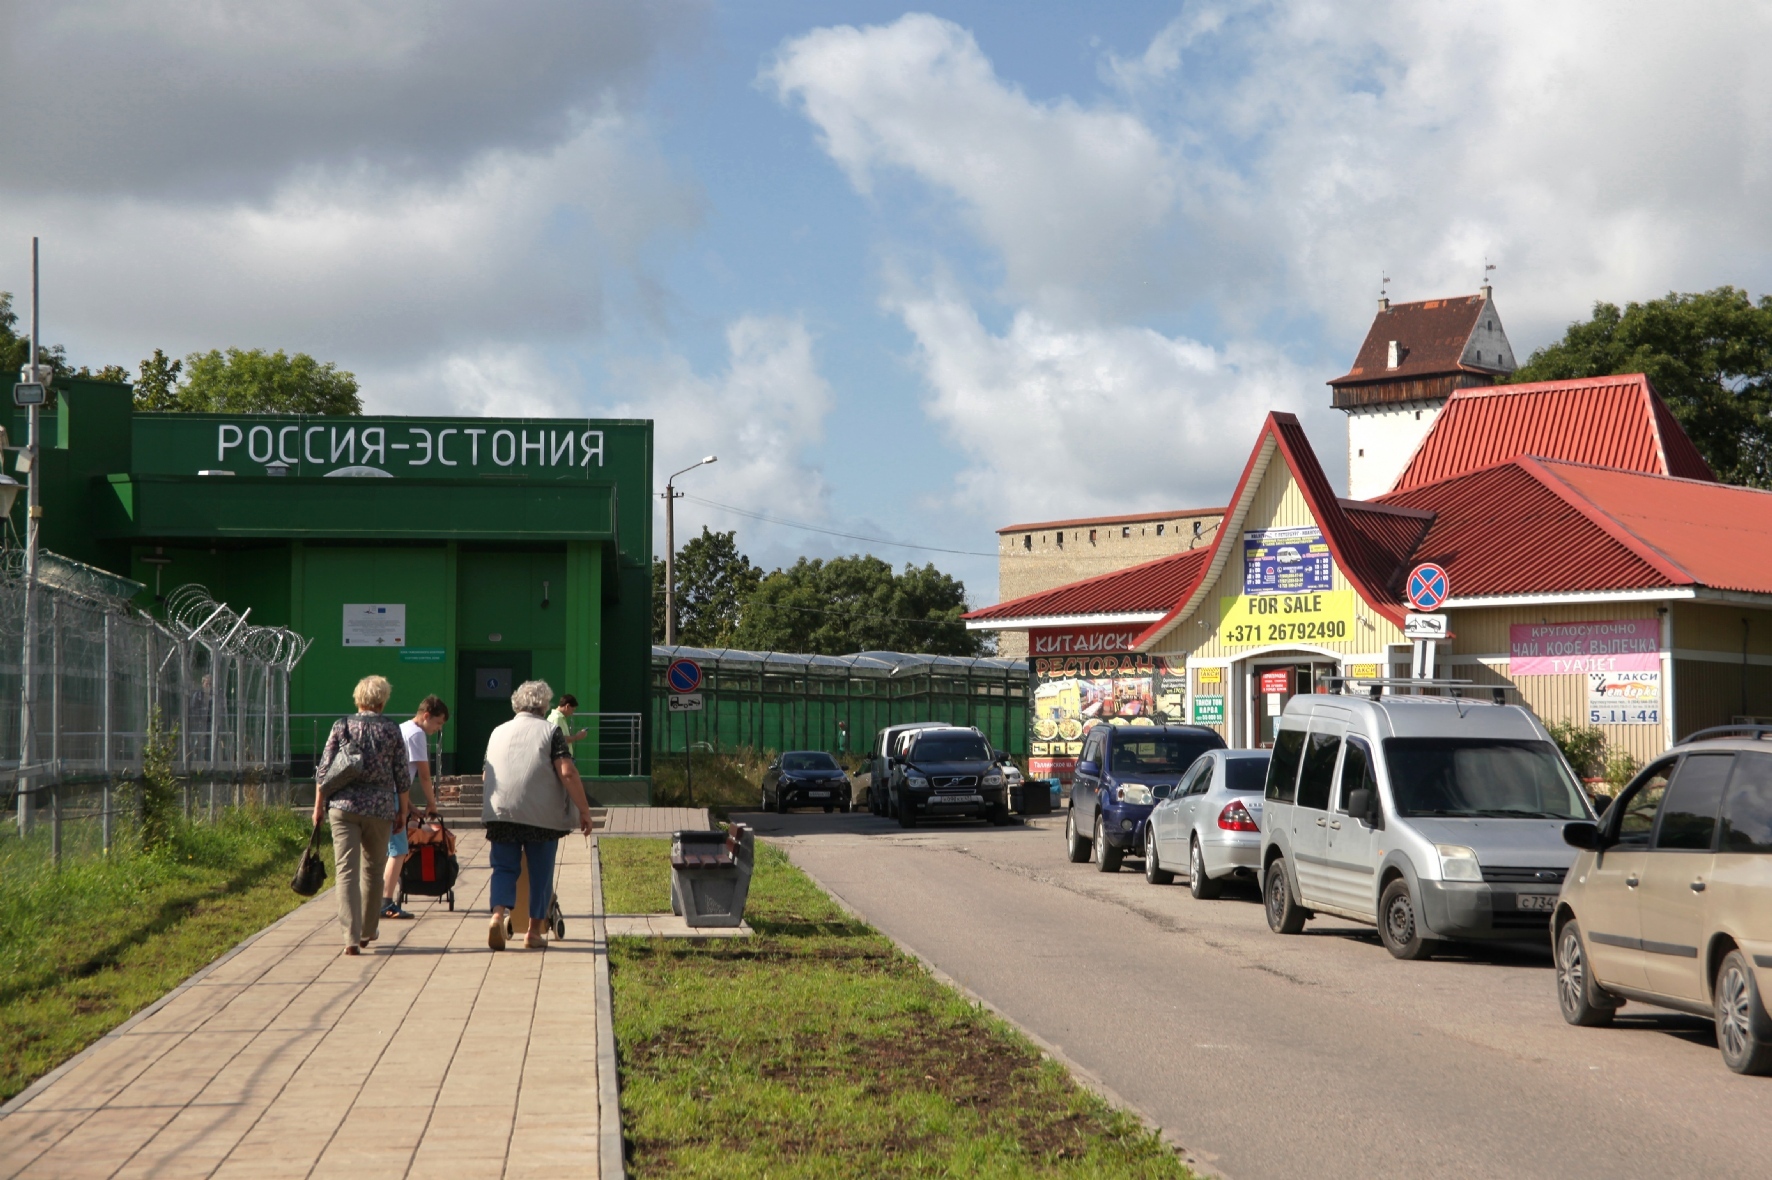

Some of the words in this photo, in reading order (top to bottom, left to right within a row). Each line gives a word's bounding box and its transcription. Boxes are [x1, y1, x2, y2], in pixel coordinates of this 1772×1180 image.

[217, 424, 604, 467] РОССИЯ-ЭСТОНИЯ
[1248, 597, 1278, 615] FOR
[1283, 595, 1322, 614] SALE
[1226, 624, 1262, 642] +371
[1268, 620, 1346, 641] 26792490
[1531, 624, 1636, 638] КРУГЛОСУТОЧНО
[1589, 638, 1657, 655] ВЫПЕЧКА
[1035, 654, 1155, 678] РЕСТОРАН
[1551, 658, 1617, 672] ТУАЛЕТ
[1617, 673, 1658, 681] ТАКСИ
[1590, 710, 1658, 722] 5-11-44
